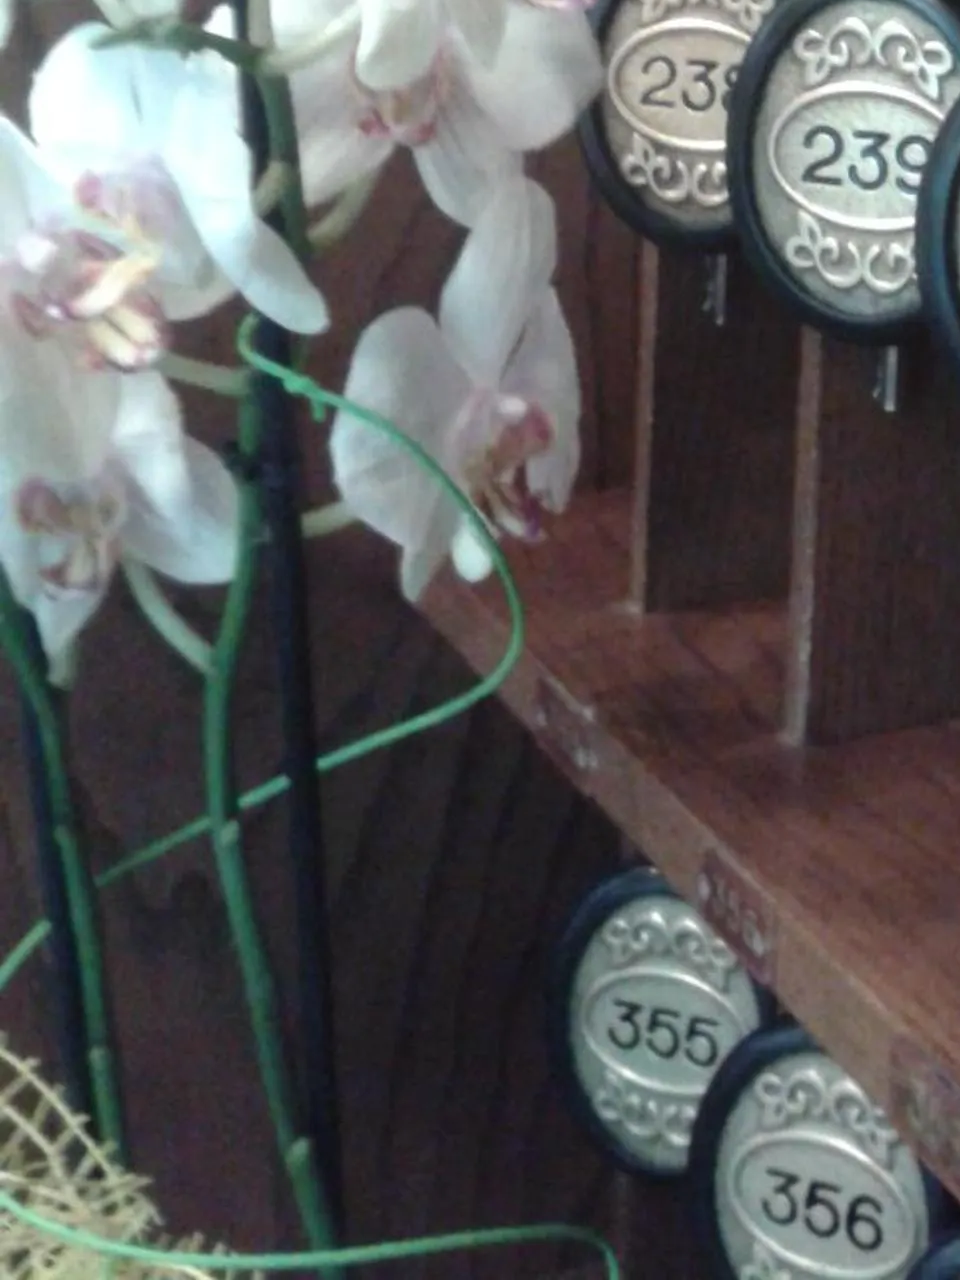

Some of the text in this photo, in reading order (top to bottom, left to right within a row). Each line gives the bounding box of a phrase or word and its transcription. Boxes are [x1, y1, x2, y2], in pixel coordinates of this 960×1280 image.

[802, 125, 933, 195] 239
[607, 998, 719, 1069] 355
[760, 1167, 885, 1253] 356
